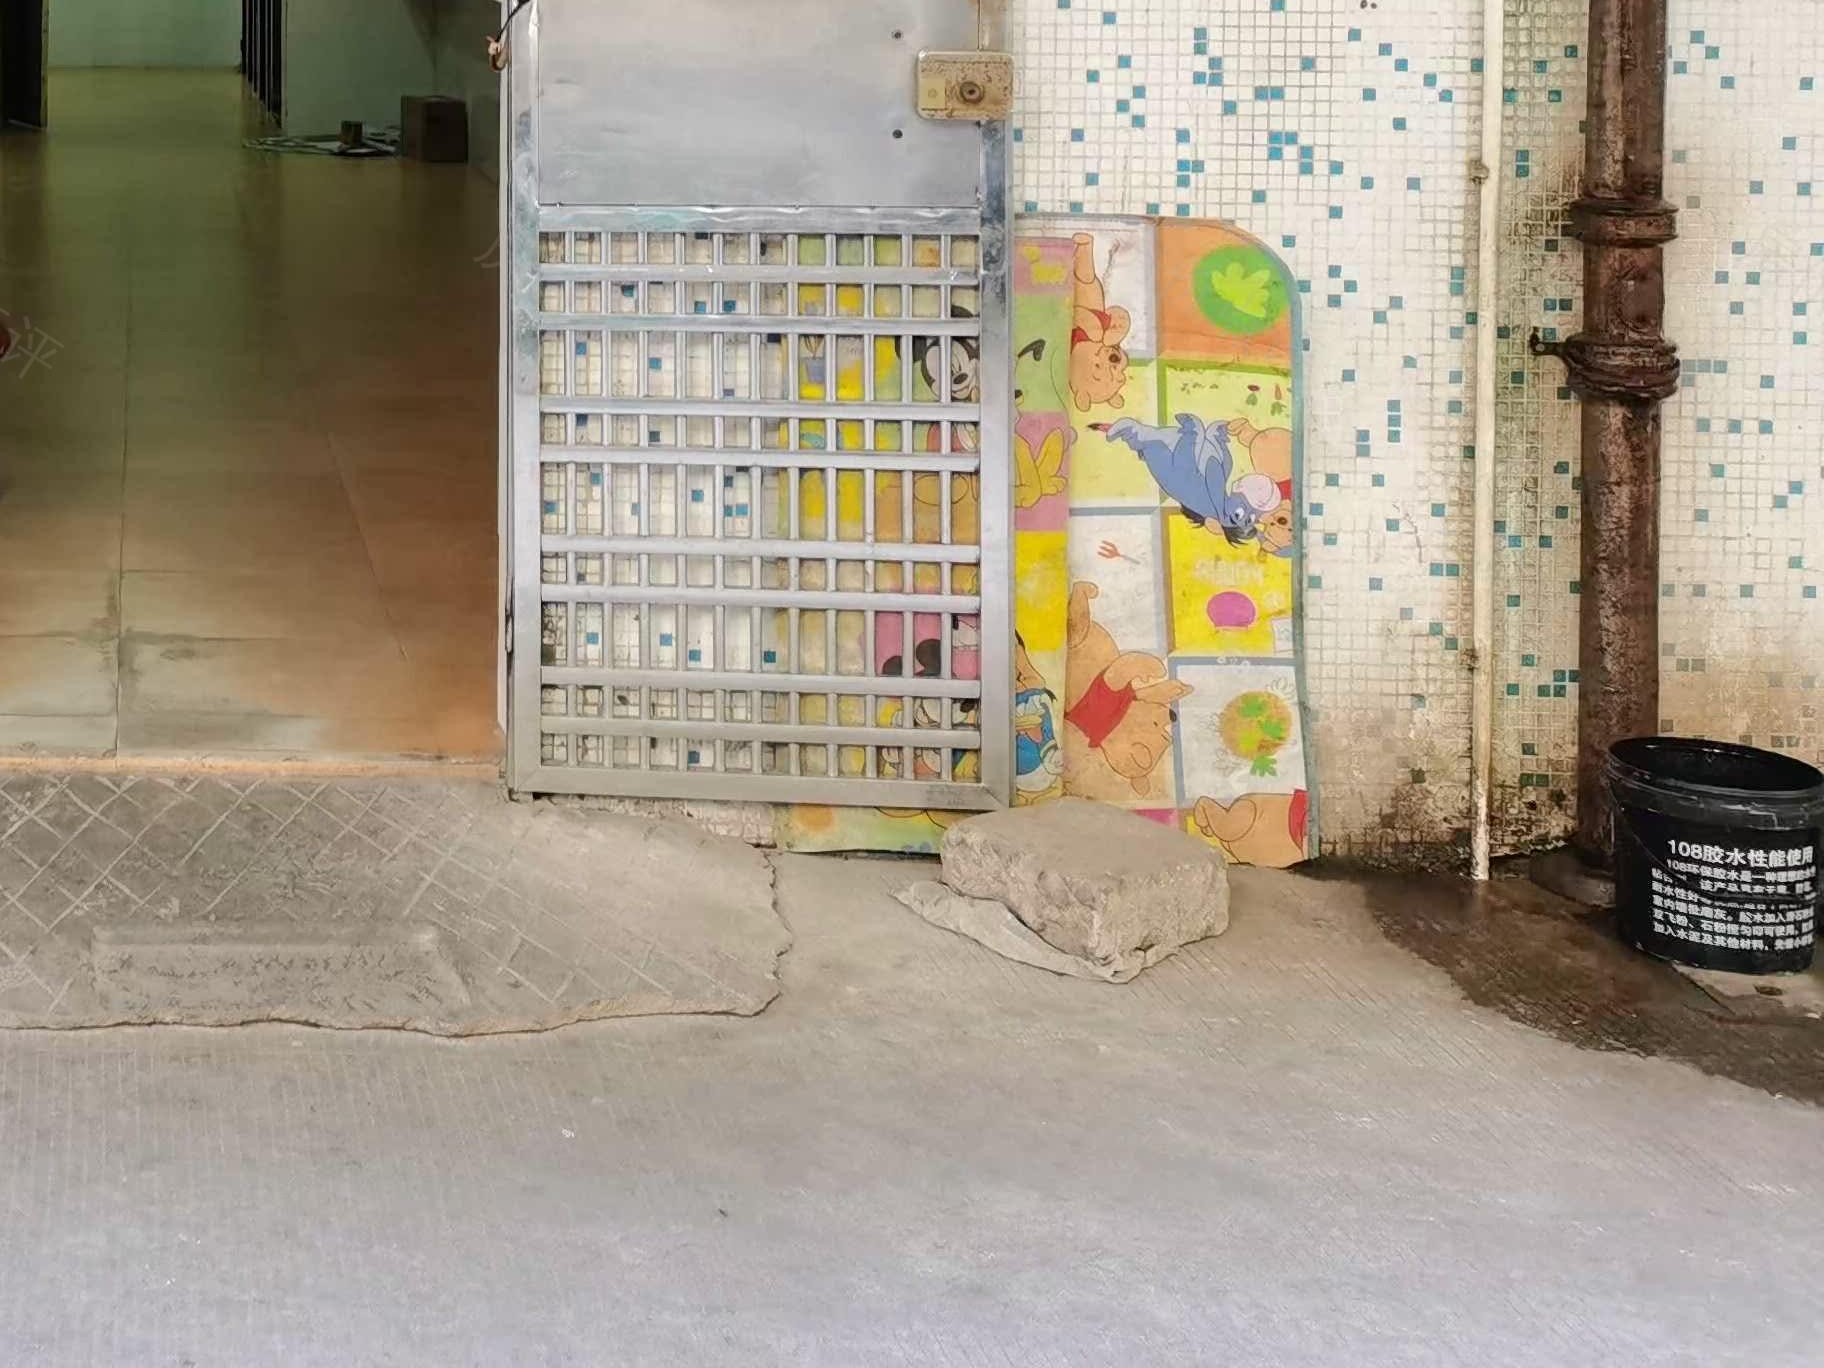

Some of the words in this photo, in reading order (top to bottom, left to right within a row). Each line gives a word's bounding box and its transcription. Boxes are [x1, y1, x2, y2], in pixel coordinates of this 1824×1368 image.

[1667, 839, 1814, 869] 108胶水性能使用
